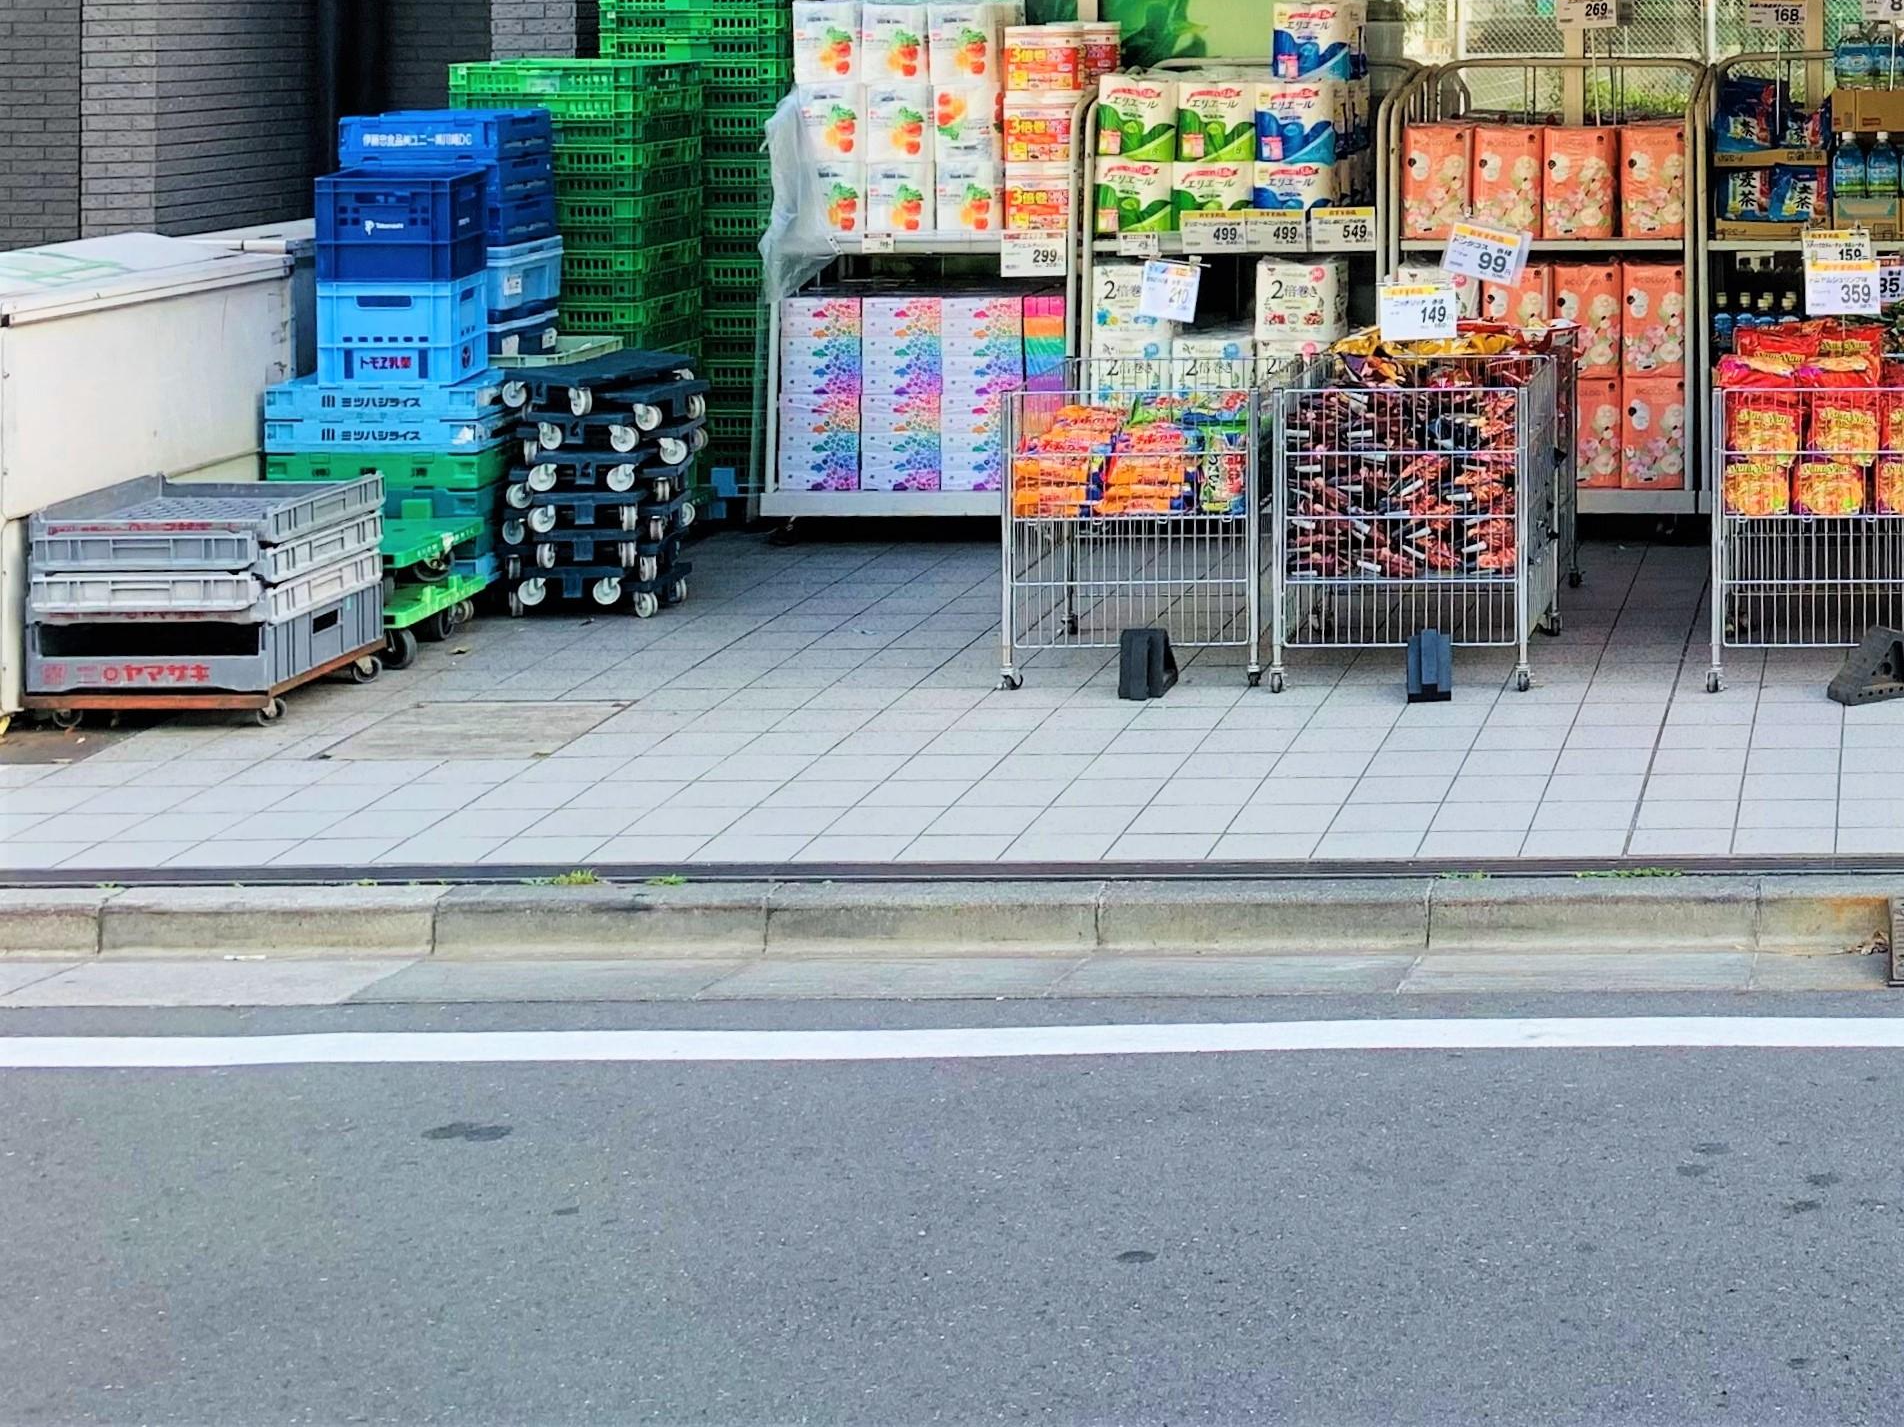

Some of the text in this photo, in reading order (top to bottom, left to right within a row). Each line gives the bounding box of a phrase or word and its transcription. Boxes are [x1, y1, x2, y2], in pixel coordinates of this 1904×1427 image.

[1271, 280, 1317, 299] 2倍巻き
[341, 397, 421, 408] ミツハシライス
[341, 430, 421, 441] ミツハシライス
